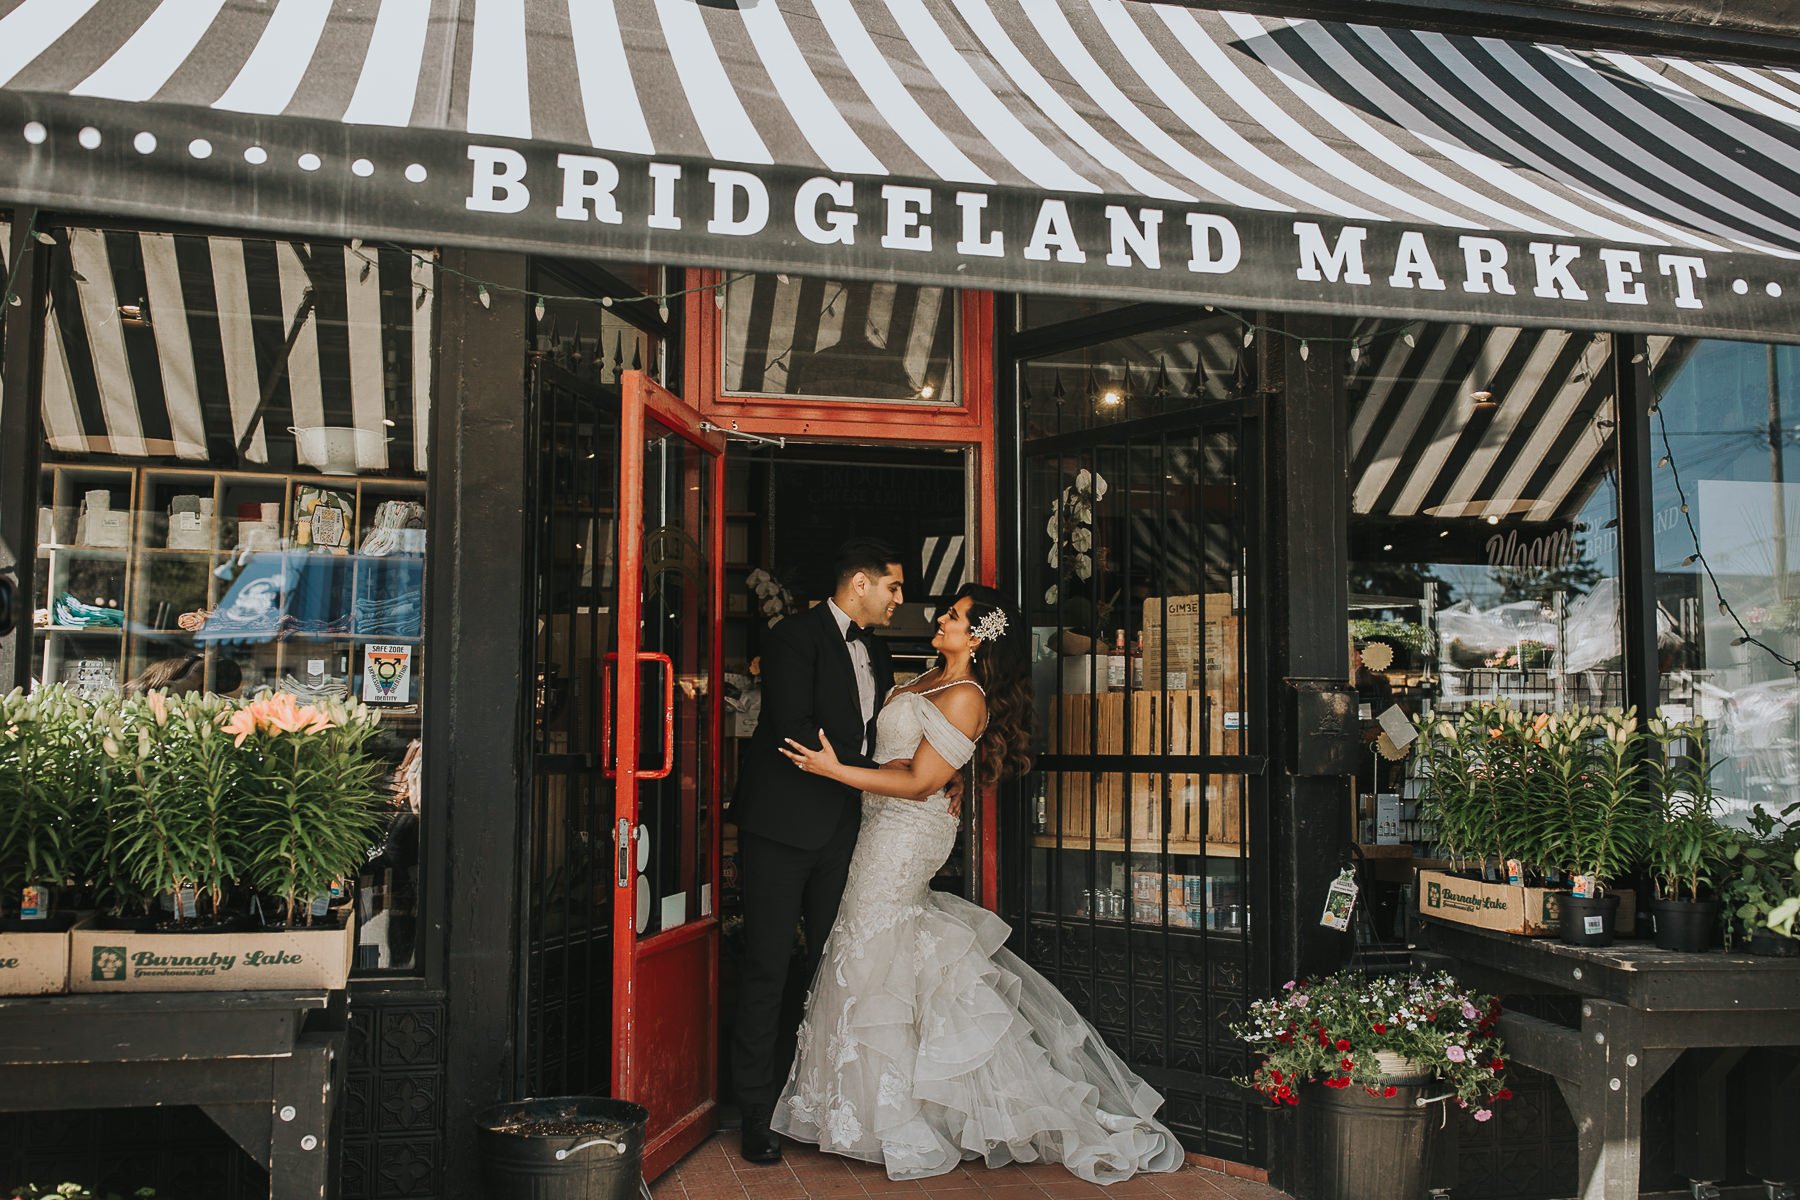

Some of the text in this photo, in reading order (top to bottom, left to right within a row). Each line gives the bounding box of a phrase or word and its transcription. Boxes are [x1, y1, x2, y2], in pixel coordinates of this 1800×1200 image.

[465, 145, 1708, 309] BRIDGELAND MARKET
[372, 645, 404, 653] SAFE ZONE
[1441, 888, 1508, 911] Burnaby Lake
[131, 950, 303, 971] Burnaby Lake
